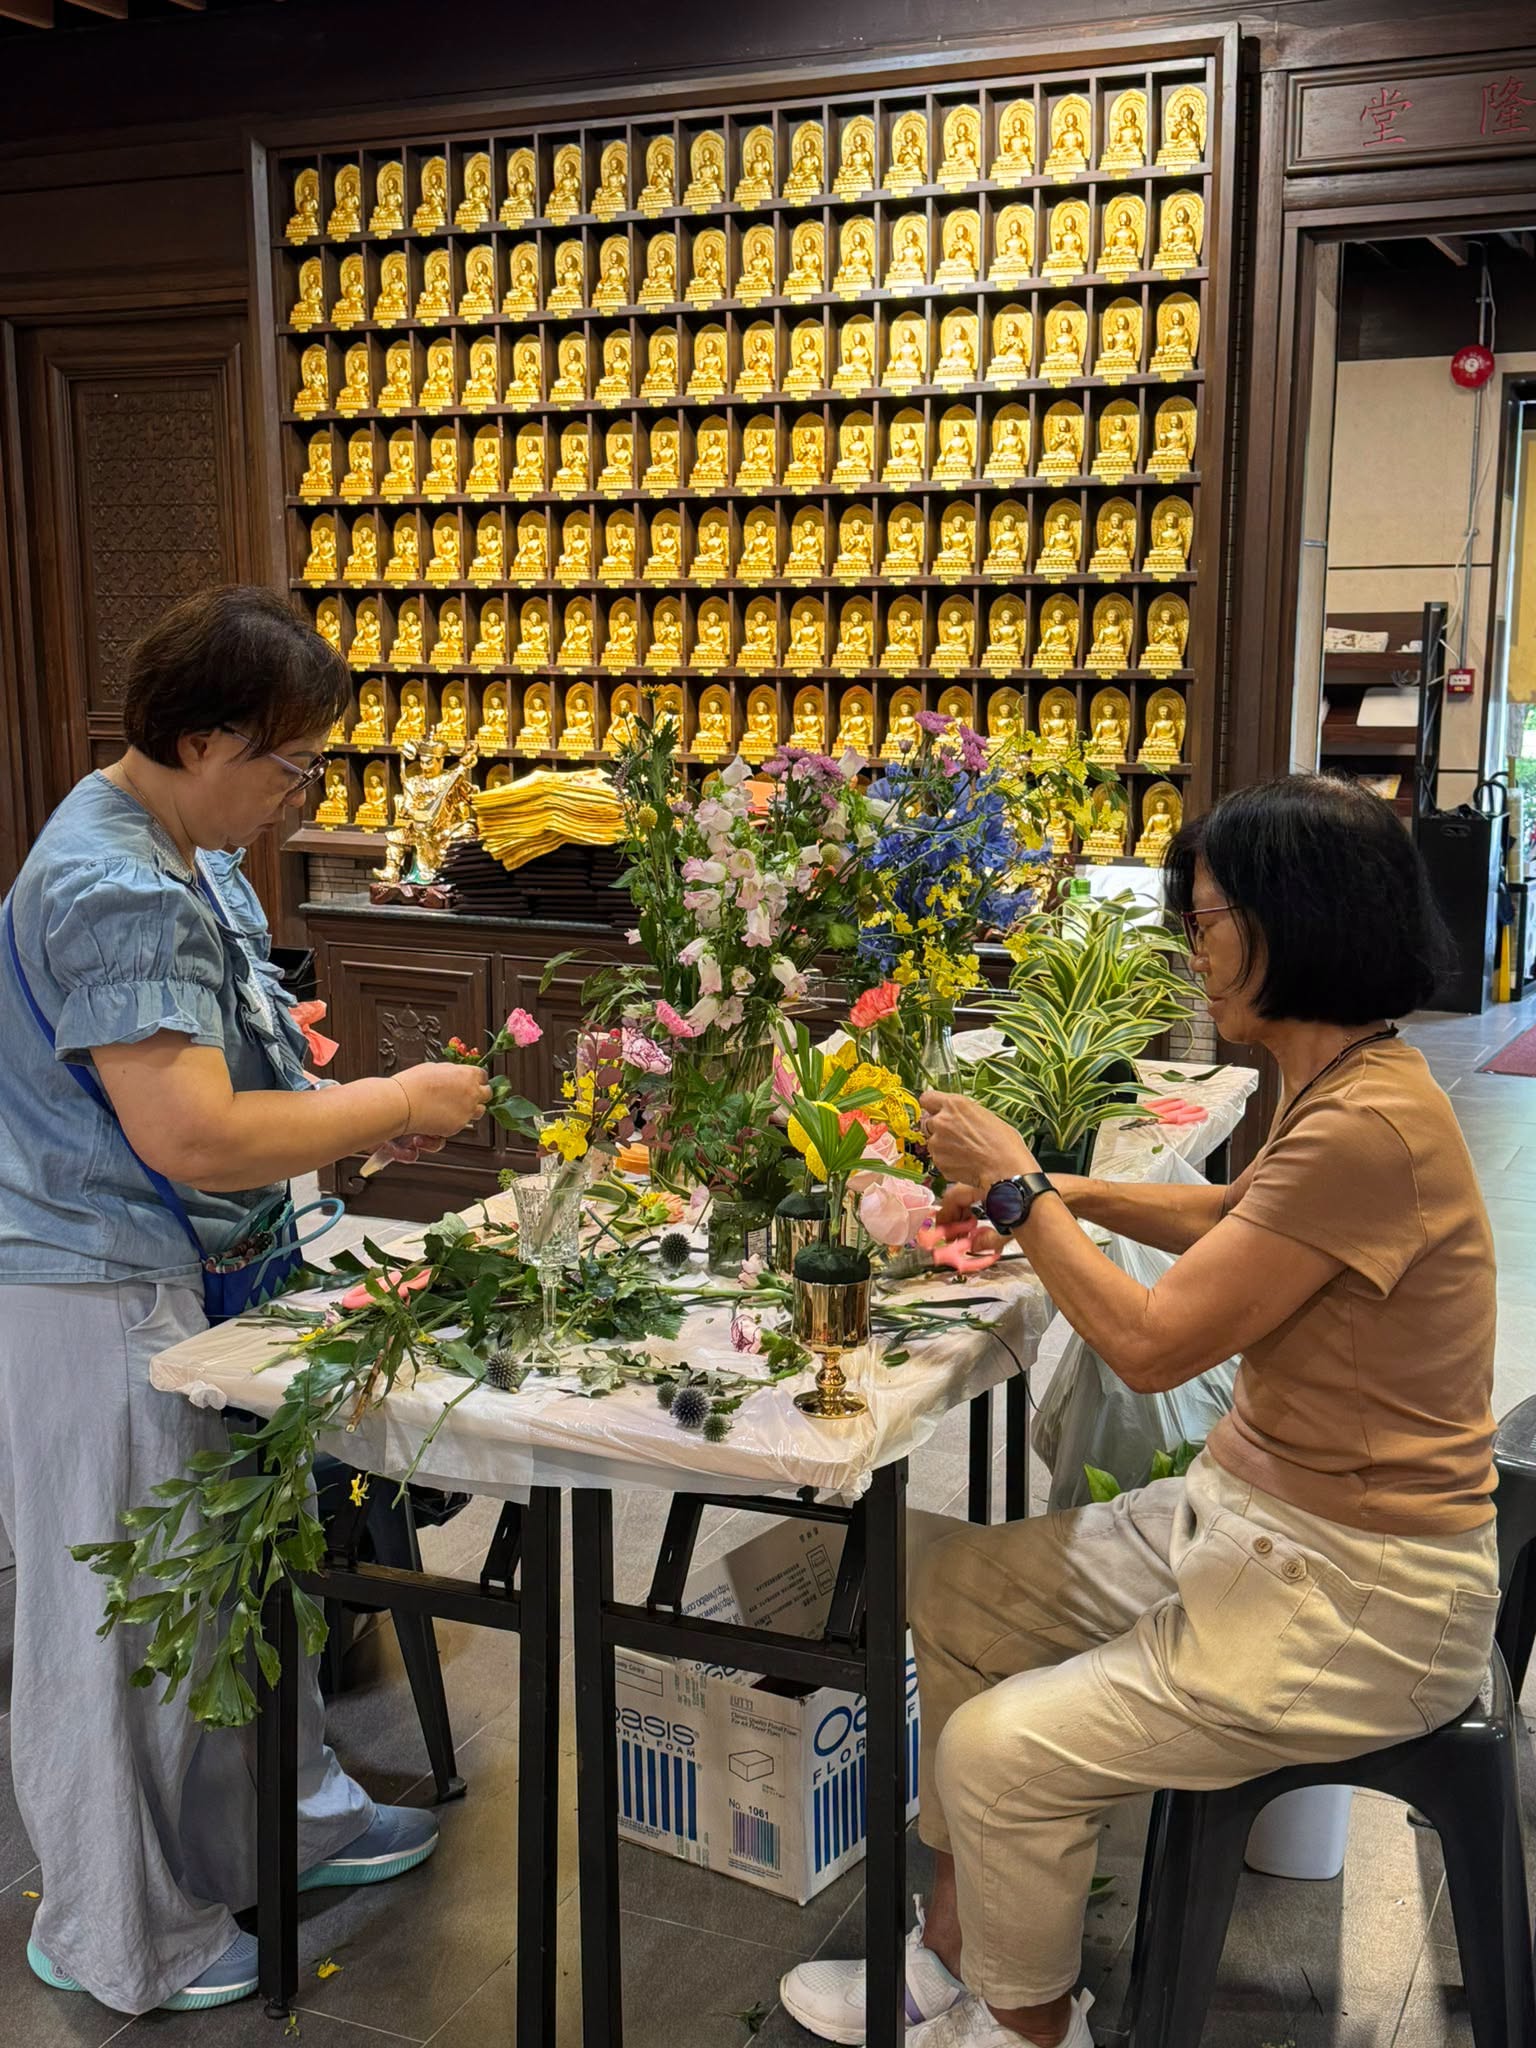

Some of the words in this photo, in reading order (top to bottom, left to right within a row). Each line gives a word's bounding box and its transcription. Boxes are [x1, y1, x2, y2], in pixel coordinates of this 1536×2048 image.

[615, 1706, 696, 1746] asis
[615, 1726, 649, 1744] ORAL
[656, 1740, 696, 1759] FOAM
[813, 1737, 866, 1785] FLOR
